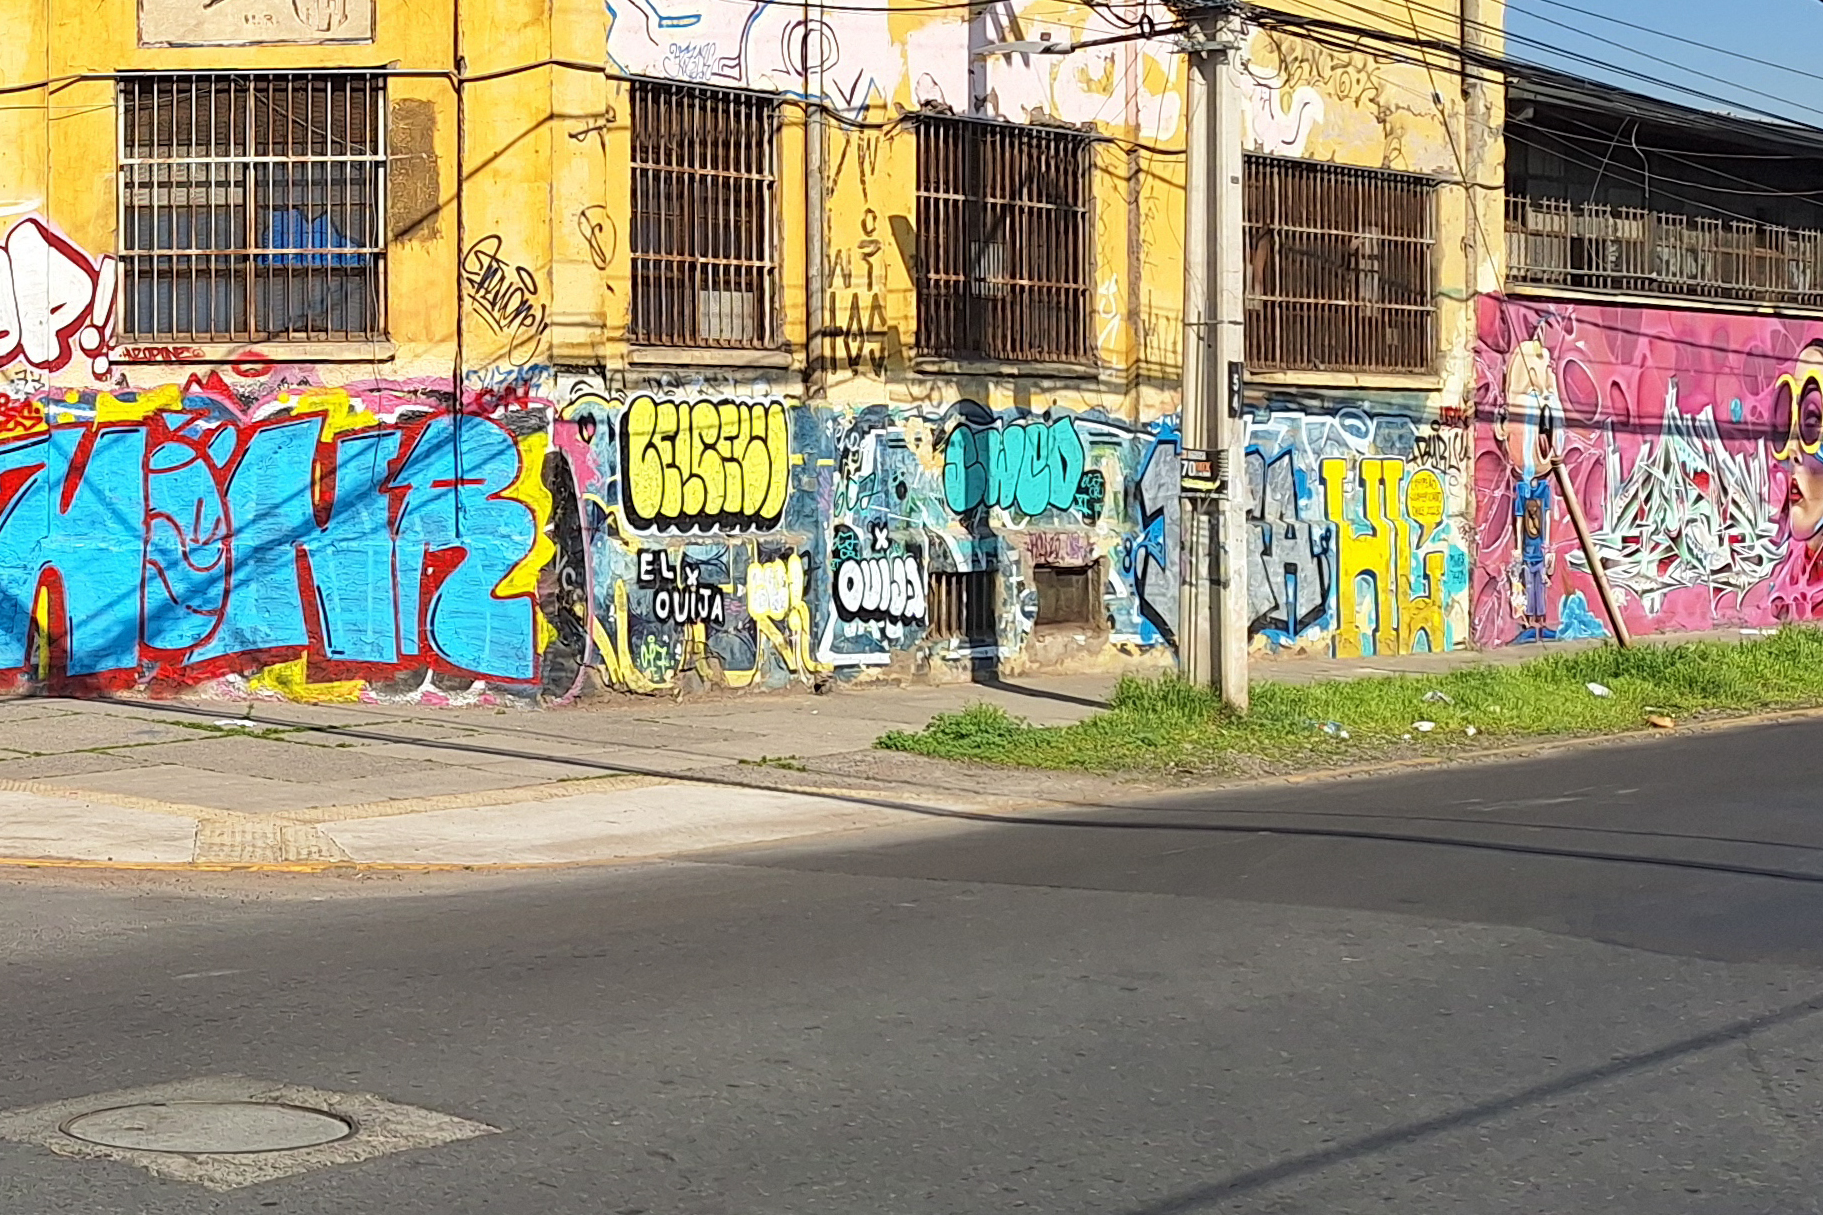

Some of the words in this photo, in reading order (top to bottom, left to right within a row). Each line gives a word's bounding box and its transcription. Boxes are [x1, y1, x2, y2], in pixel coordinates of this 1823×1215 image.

[640, 551, 675, 581] EL
[655, 587, 724, 624] OUIJA
[838, 555, 926, 619] OUIJA
